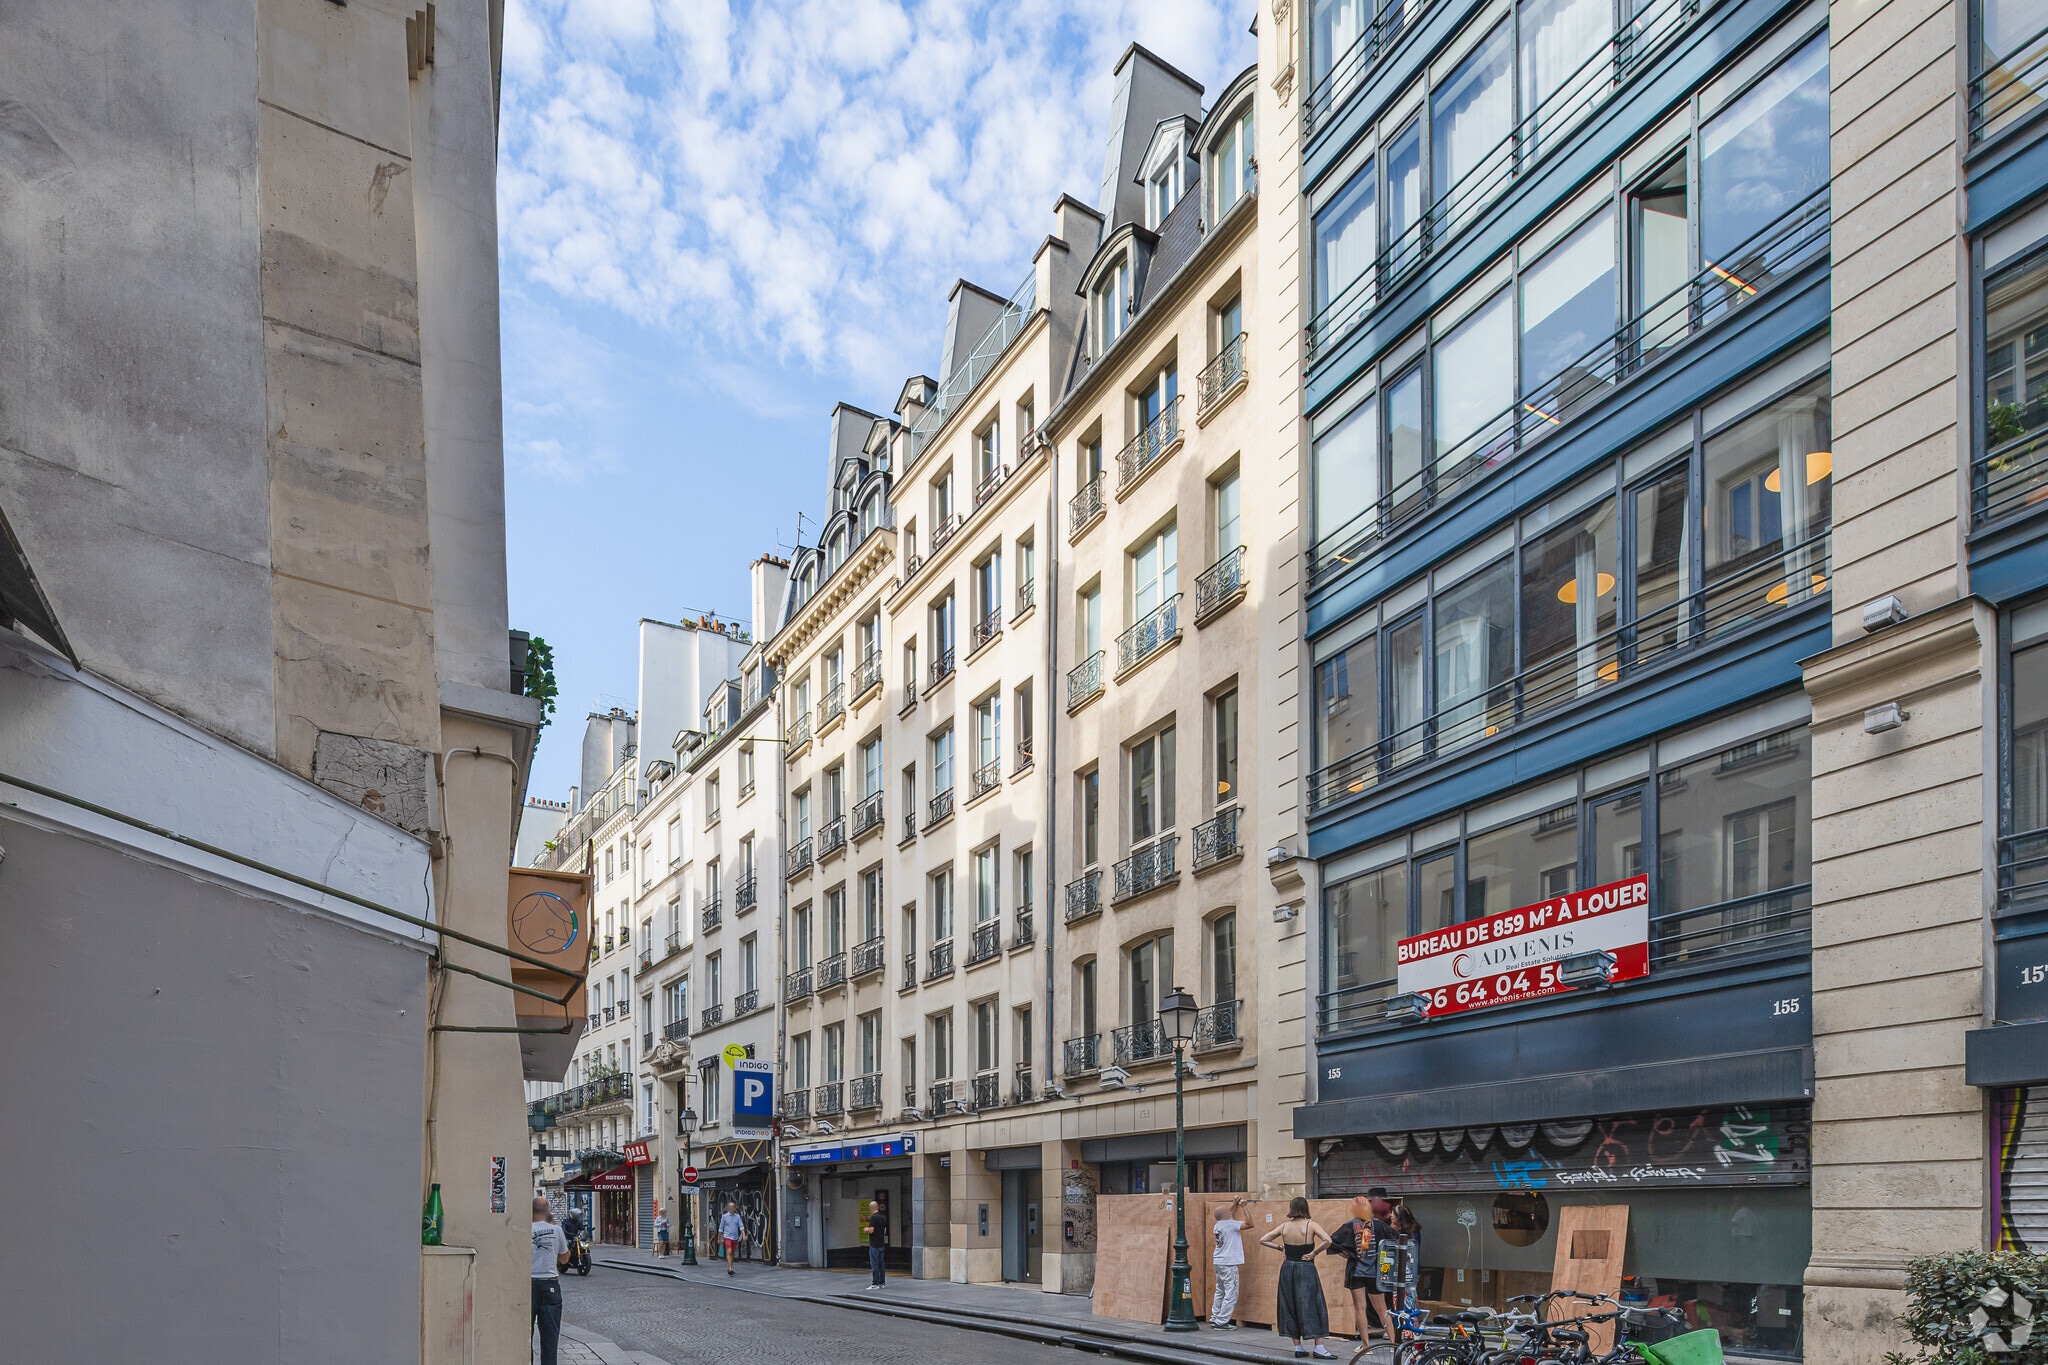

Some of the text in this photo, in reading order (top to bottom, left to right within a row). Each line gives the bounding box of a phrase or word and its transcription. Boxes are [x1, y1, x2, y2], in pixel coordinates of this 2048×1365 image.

[1398, 930, 1462, 962] BUREAU
[1466, 923, 1489, 945] DE
[1493, 914, 1525, 938] 859
[1557, 897, 1573, 922] À
[1577, 882, 1647, 917] LOUER
[1479, 930, 1575, 967] ADVENIS
[1505, 963, 1520, 971] Real
[1520, 959, 1541, 968] Estate
[1455, 980, 1488, 1004] 64
[1495, 970, 1531, 996] 04
[1467, 986, 1556, 1009] www.advenis-res.com
[1773, 997, 1800, 1016] 155
[1327, 1067, 1341, 1080] 155
[744, 1078, 765, 1107] P
[904, 1138, 913, 1151] P
[790, 1154, 795, 1164] P
